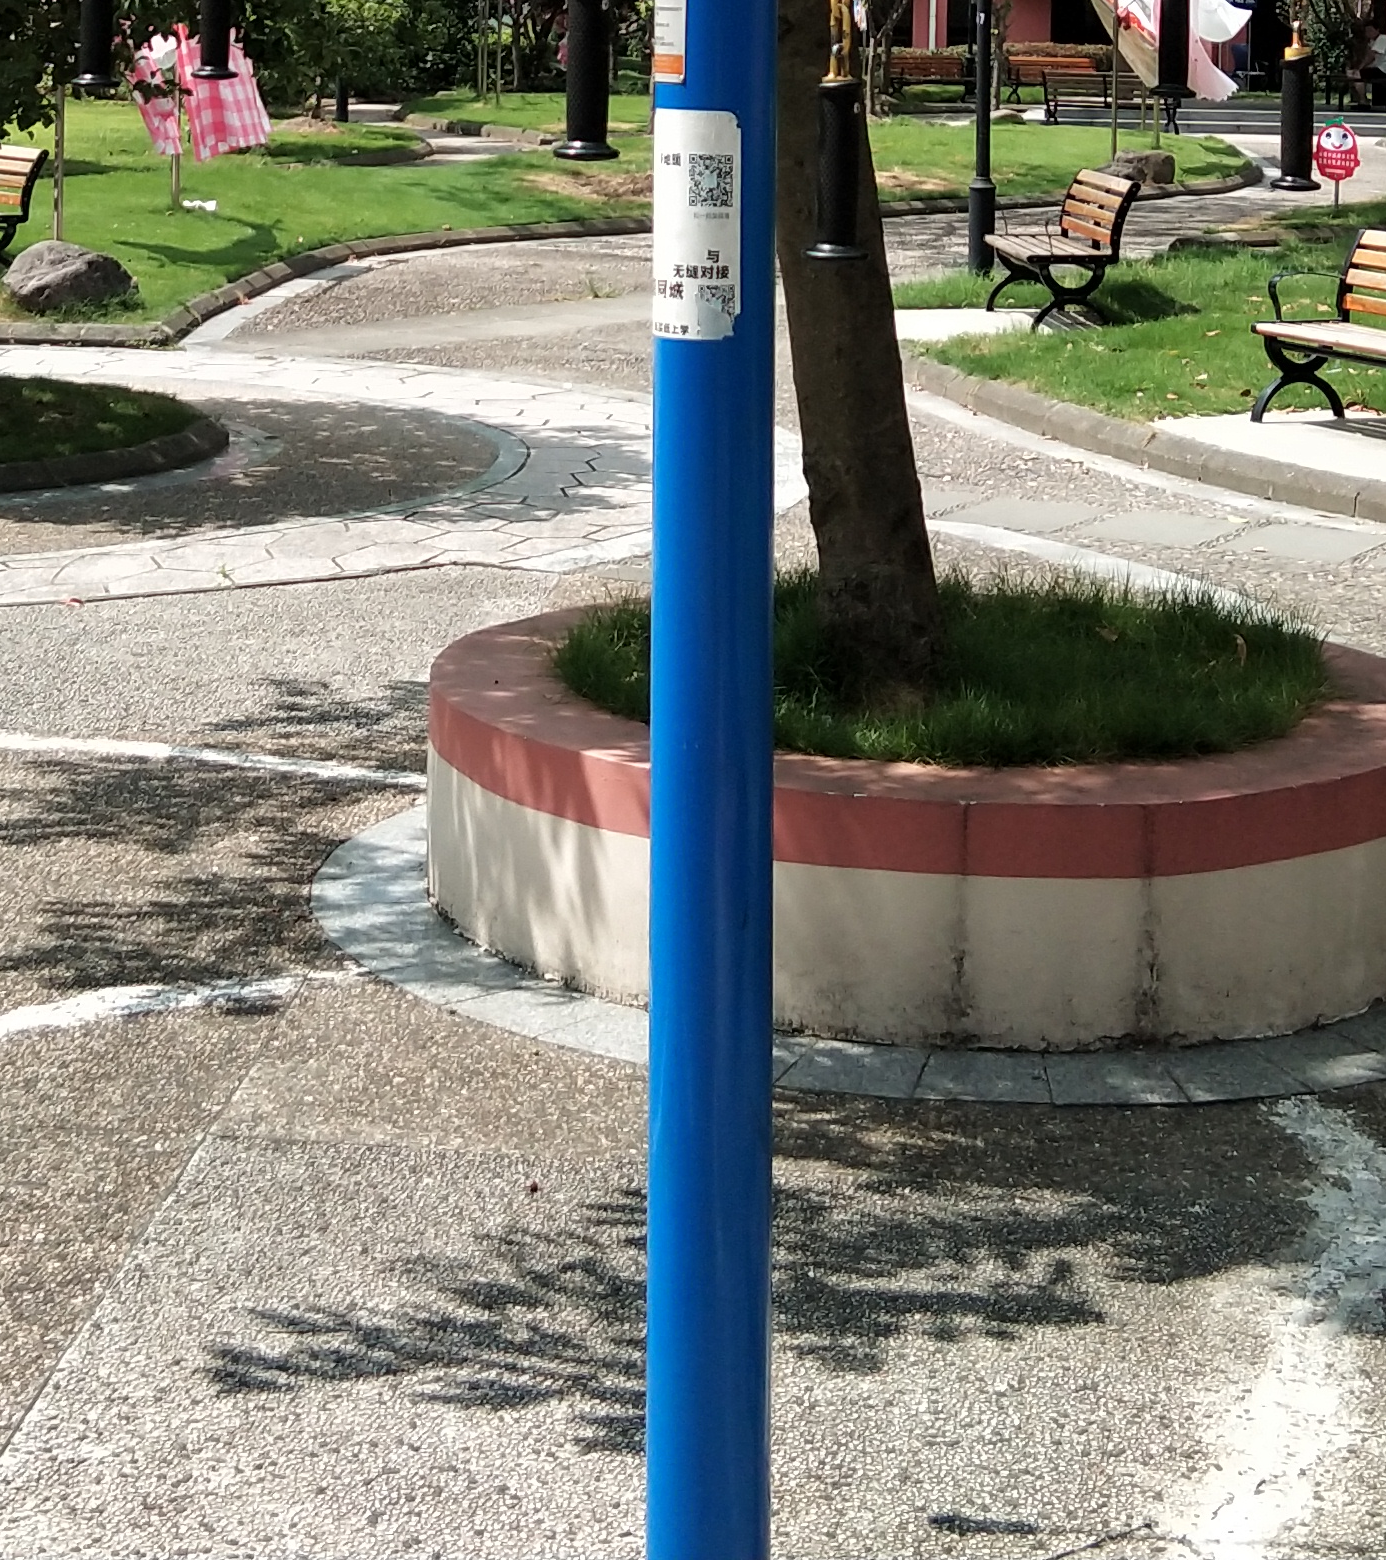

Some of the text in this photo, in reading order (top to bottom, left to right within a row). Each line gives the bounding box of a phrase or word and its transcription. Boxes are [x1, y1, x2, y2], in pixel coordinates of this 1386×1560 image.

[706, 249, 720, 264] 与
[673, 263, 730, 280] 无缝对接
